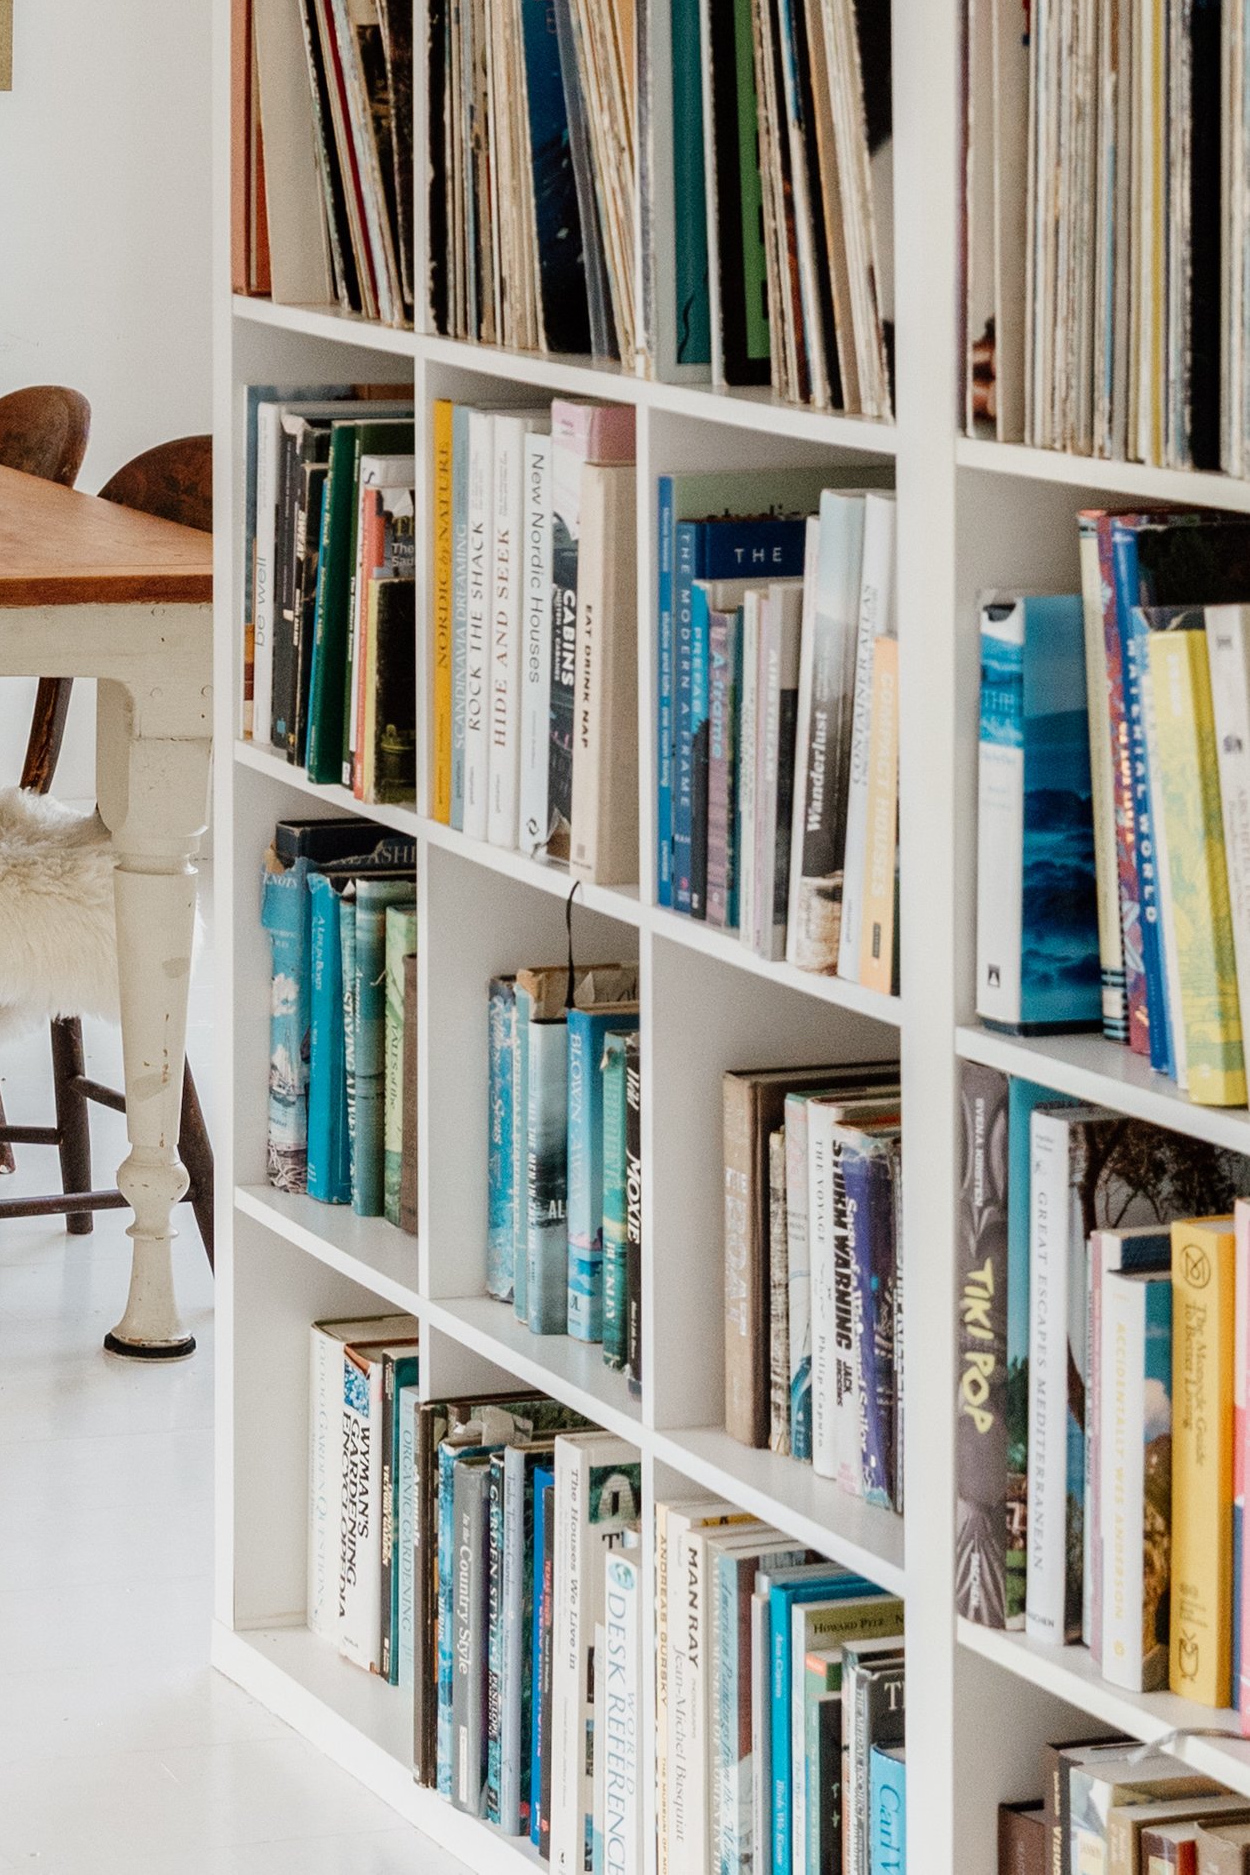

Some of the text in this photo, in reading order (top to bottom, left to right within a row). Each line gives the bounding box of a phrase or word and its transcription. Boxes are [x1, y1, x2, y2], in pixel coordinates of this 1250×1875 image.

[296, 510, 307, 561] SWEAT
[323, 512, 331, 546] Book
[439, 442, 449, 542] NATURE
[255, 557, 267, 647] be well
[456, 524, 467, 622] DREAMING
[470, 521, 483, 599] SHACK
[496, 528, 509, 599] SEEK
[530, 454, 544, 683] New Nordic Houses
[734, 547, 782, 564] THE
[437, 569, 448, 669] NORDIC
[470, 612, 482, 654] THE
[495, 611, 508, 667] AND
[561, 588, 575, 686] CABINS
[681, 533, 691, 687] THE MODERN
[455, 625, 466, 749] SCANDINAVIA
[468, 666, 481, 732] ROCK
[494, 678, 507, 747] HIDE
[584, 645, 592, 703] DRINK
[693, 627, 703, 713] PREFAB
[713, 652, 726, 759] A-frame
[581, 710, 589, 749] NAP
[852, 658, 866, 785] CONTAINER
[806, 711, 827, 832] Wanderlust
[871, 670, 894, 897] COMPACT HOUSES
[1139, 812, 1158, 923] WORLD
[342, 991, 354, 1072] STAYING
[390, 1071, 397, 1084] of
[528, 1128, 536, 1151] THE
[570, 1033, 582, 1200] BLOWN AWAY
[974, 1098, 984, 1206] SVEN KIRSTEN
[528, 1153, 536, 1180] MEN
[528, 1182, 536, 1197] IN
[627, 1151, 641, 1244] MOXIE
[815, 1139, 825, 1244] THE VOYAGE
[835, 1234, 853, 1350] WARNING
[817, 1336, 826, 1448] Philip Caputo
[843, 1361, 853, 1395] JACK
[962, 1257, 995, 1434] TIKI POP
[1034, 1191, 1048, 1571] GREAT ESCAPES MEDITERRANEAN
[1183, 1323, 1197, 1432] Better Living
[1196, 1304, 1207, 1467] The Monocle Guide
[857, 1391, 869, 1452] Sailor
[316, 1410, 328, 1608] GARDEN QUESTIONS
[339, 1411, 351, 1617] ENCYCLOPEDIA
[347, 1419, 360, 1587] GARDENING
[358, 1427, 371, 1539] WYMAN'S
[506, 1474, 516, 1506] Tasha
[1114, 1323, 1127, 1620] ACCIDENTALLY WES ANDERSON
[402, 1430, 412, 1633] ORGANIC GARDENING
[489, 1485, 499, 1579] GARDEN
[505, 1552, 515, 1597] Garden
[569, 1469, 578, 1670] The Houses We Live in
[971, 1552, 980, 1606] TASCHEN
[456, 1513, 472, 1675] In the Country Style
[688, 1547, 698, 1669] MAN RAY
[721, 1580, 733, 1656] American
[660, 1632, 668, 1708] GURSKY
[720, 1662, 733, 1742] Paintings
[607, 1592, 626, 1875] DESK REFERENCE
[627, 1692, 635, 1796] WORLD
[673, 1645, 687, 1842] Jean-Michel Basquiat
[721, 1740, 733, 1782] from
[855, 1689, 865, 1823] THE MURAL PROJECT
[713, 1756, 721, 1820] WOMEN
[776, 1779, 785, 1866] Birds We Know
[879, 1783, 902, 1853] Carl
[662, 1838, 667, 1853] OF
